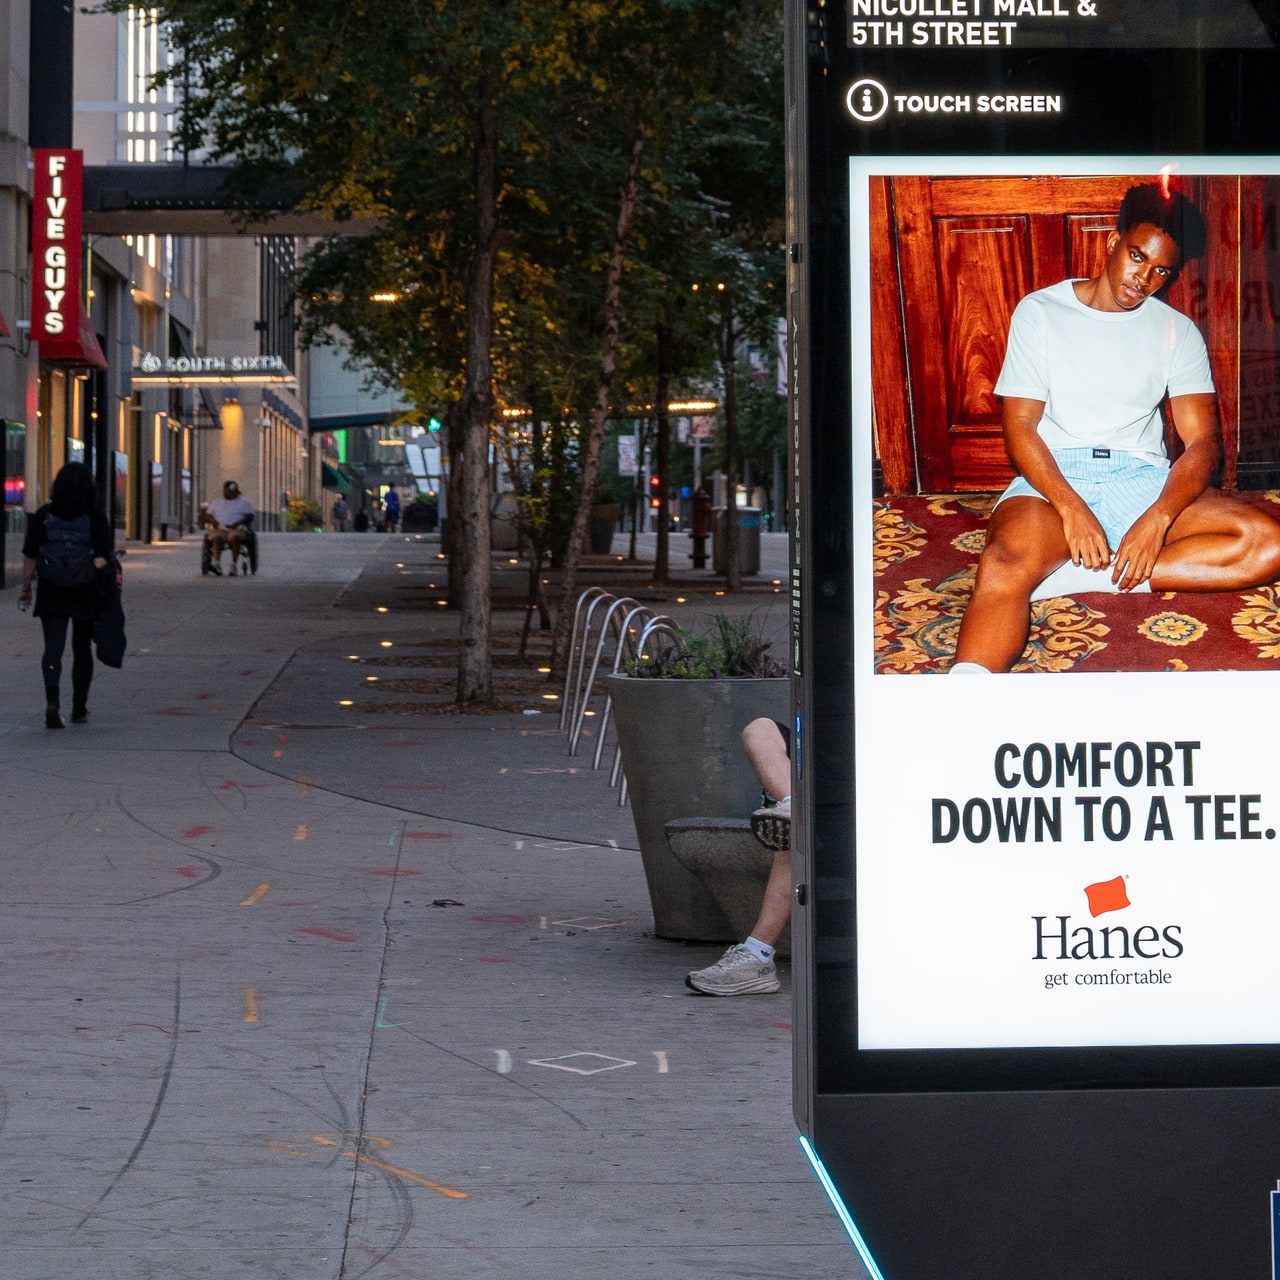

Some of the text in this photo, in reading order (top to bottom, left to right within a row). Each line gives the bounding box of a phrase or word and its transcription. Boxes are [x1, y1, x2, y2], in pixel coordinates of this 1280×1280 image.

[852, 21, 1017, 46] 5TH STREET
[894, 95, 1061, 113] TOUCH SCREEN
[44, 156, 67, 334] FIVE GUYS
[166, 356, 225, 372] SOUTH
[231, 355, 282, 370] SIXTH
[793, 316, 801, 564] EMERGENCY
[994, 740, 1201, 789] COMFORT
[931, 793, 1277, 844] DOWN TO A TEE.
[1031, 914, 1184, 960] Hanes
[1044, 968, 1172, 990] get comfortable
